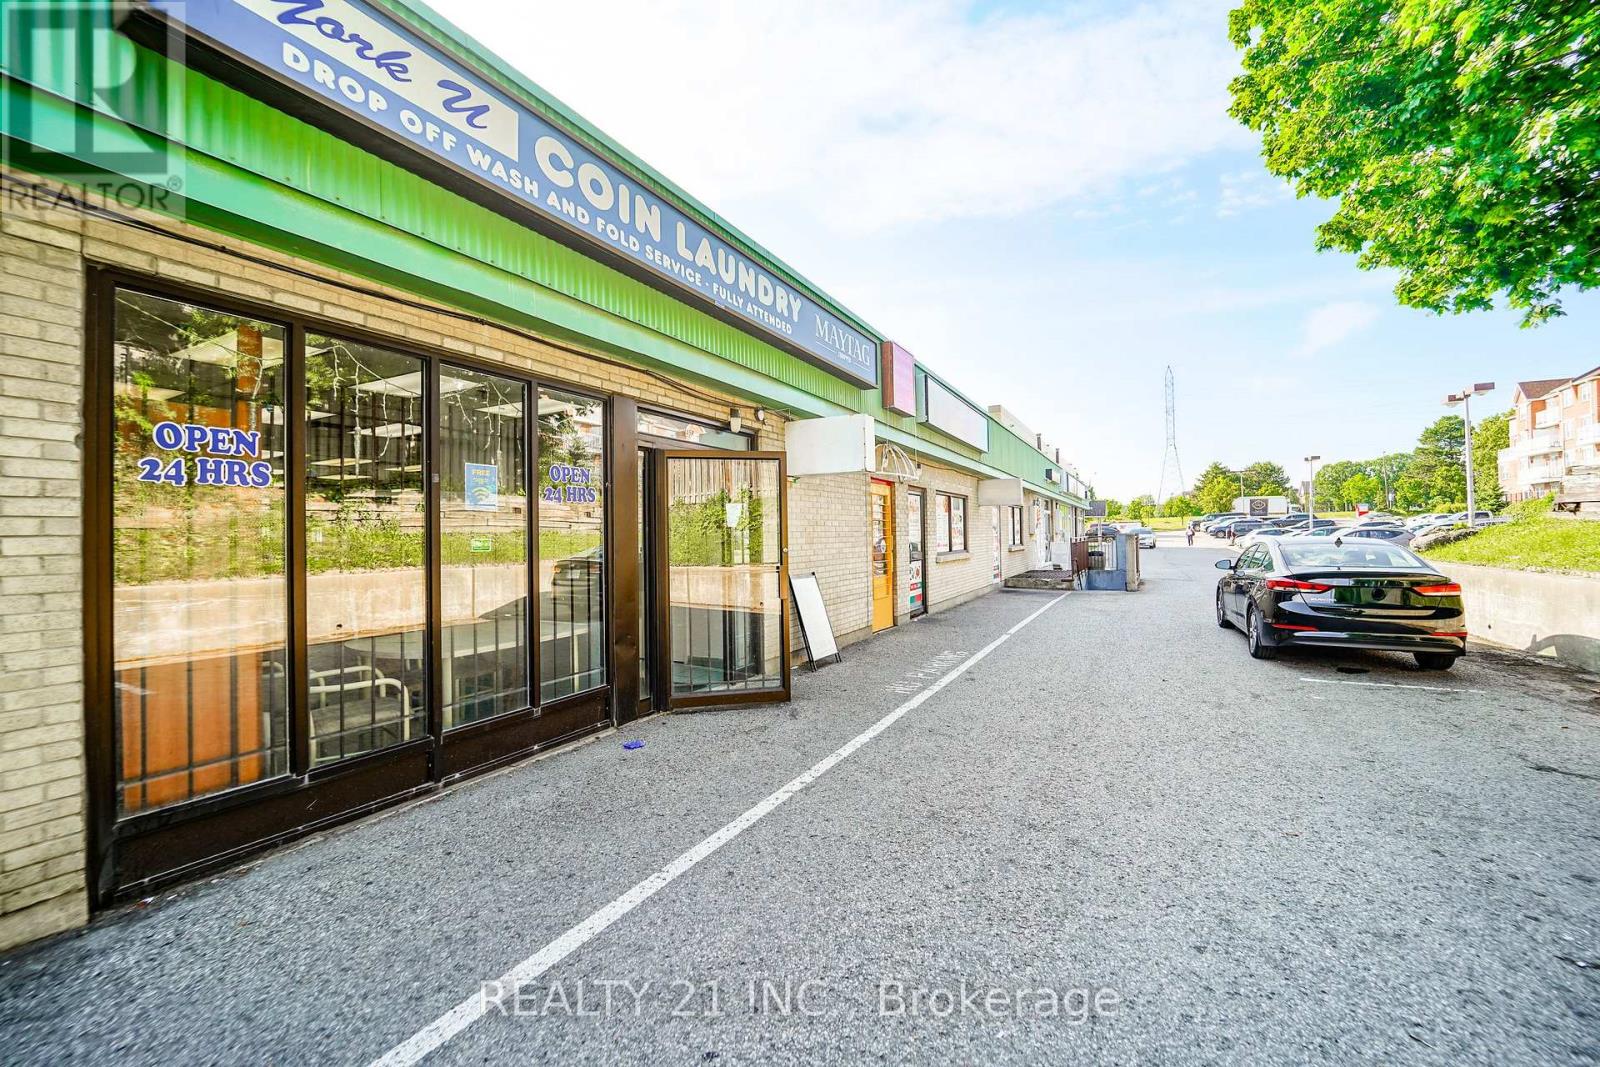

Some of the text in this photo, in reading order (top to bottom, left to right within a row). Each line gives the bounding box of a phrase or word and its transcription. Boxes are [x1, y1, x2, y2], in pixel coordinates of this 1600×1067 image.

[436, 79, 490, 129] U
[282, 41, 792, 335] DROP OFF WASH AND FOLD SERVICE FULLY ATTENDED
[534, 135, 801, 323] COIN LAUNDRY
[815, 313, 870, 366] MAYTAG
[153, 421, 260, 457] OPEN
[137, 457, 272, 487] 24 HRS
[549, 464, 592, 483] OPEN
[544, 486, 596, 504] 24 HRS
